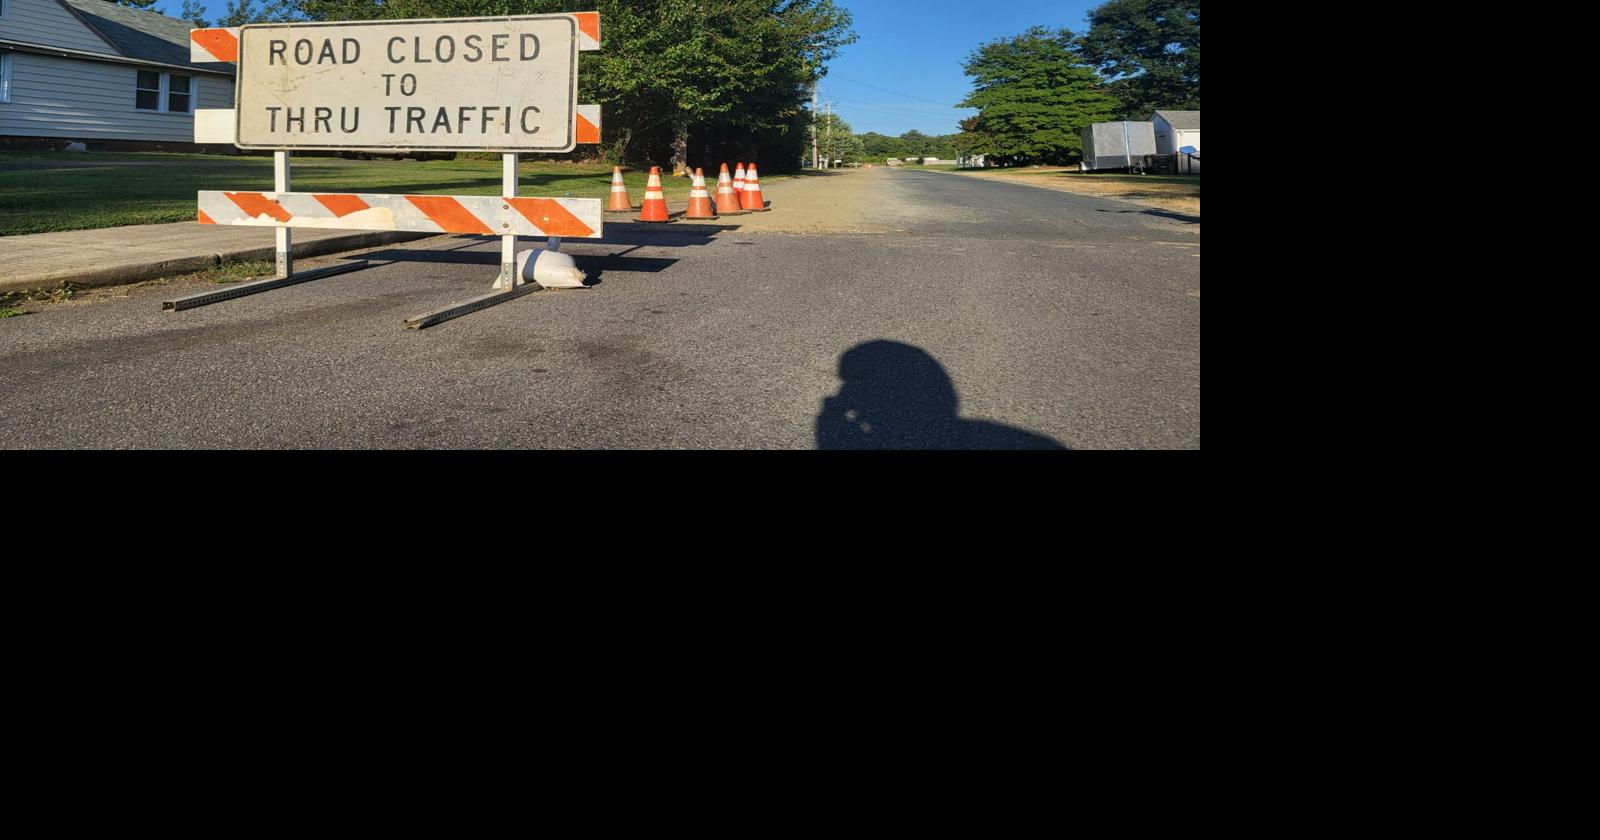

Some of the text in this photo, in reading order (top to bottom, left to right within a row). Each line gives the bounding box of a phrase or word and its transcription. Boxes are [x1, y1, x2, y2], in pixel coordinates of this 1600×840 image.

[268, 33, 541, 66] ROAD CLOSED
[381, 73, 418, 97] TO
[265, 106, 542, 135] THRU TRAFFIC
